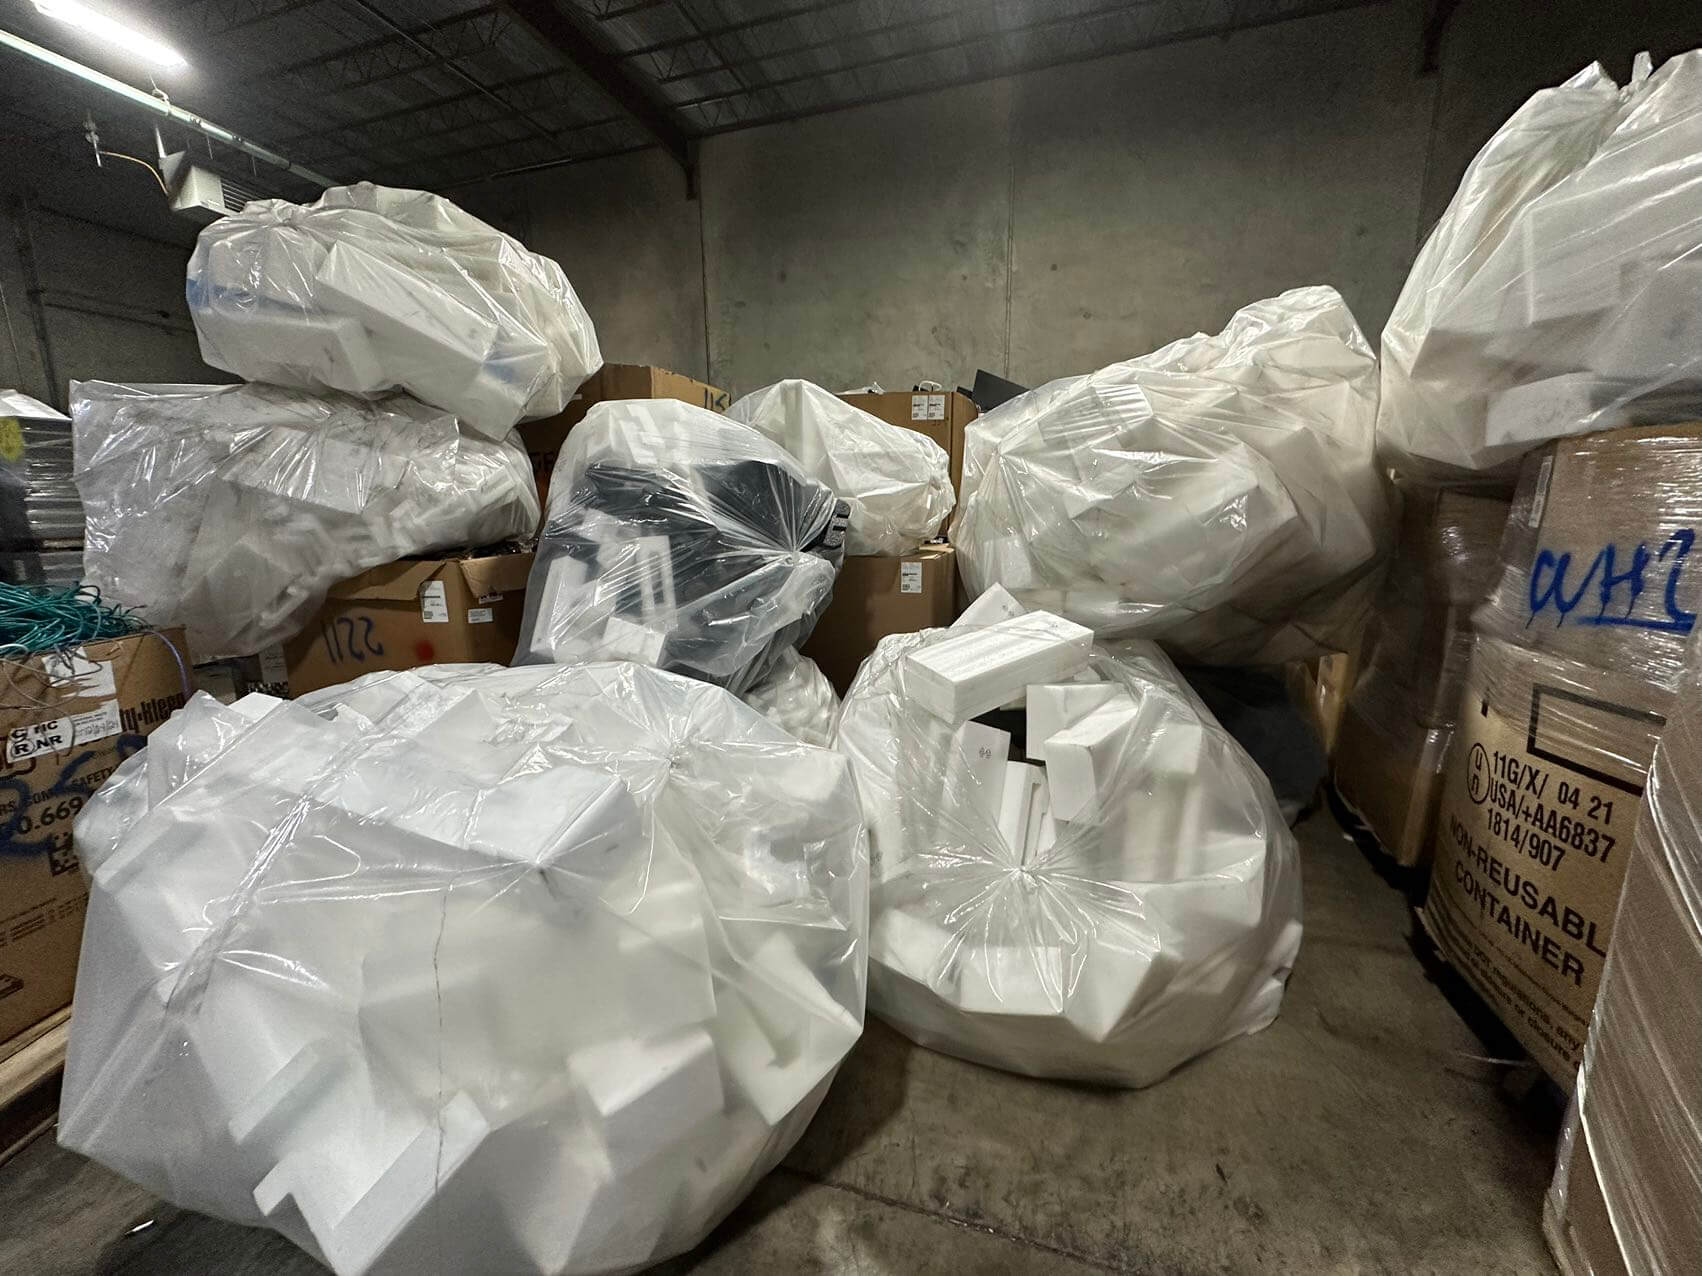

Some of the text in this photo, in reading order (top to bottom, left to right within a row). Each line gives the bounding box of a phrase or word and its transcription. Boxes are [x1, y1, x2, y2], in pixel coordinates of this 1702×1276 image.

[36, 735, 63, 749] NR
[1490, 777, 1616, 863] USA/+AA6837
[1493, 751, 1614, 825] 11G/X/ 04 21
[1487, 808, 1566, 872] 1814/907
[1451, 815, 1607, 958] NON-REUSABL
[1455, 861, 1585, 987] CONTAINER
